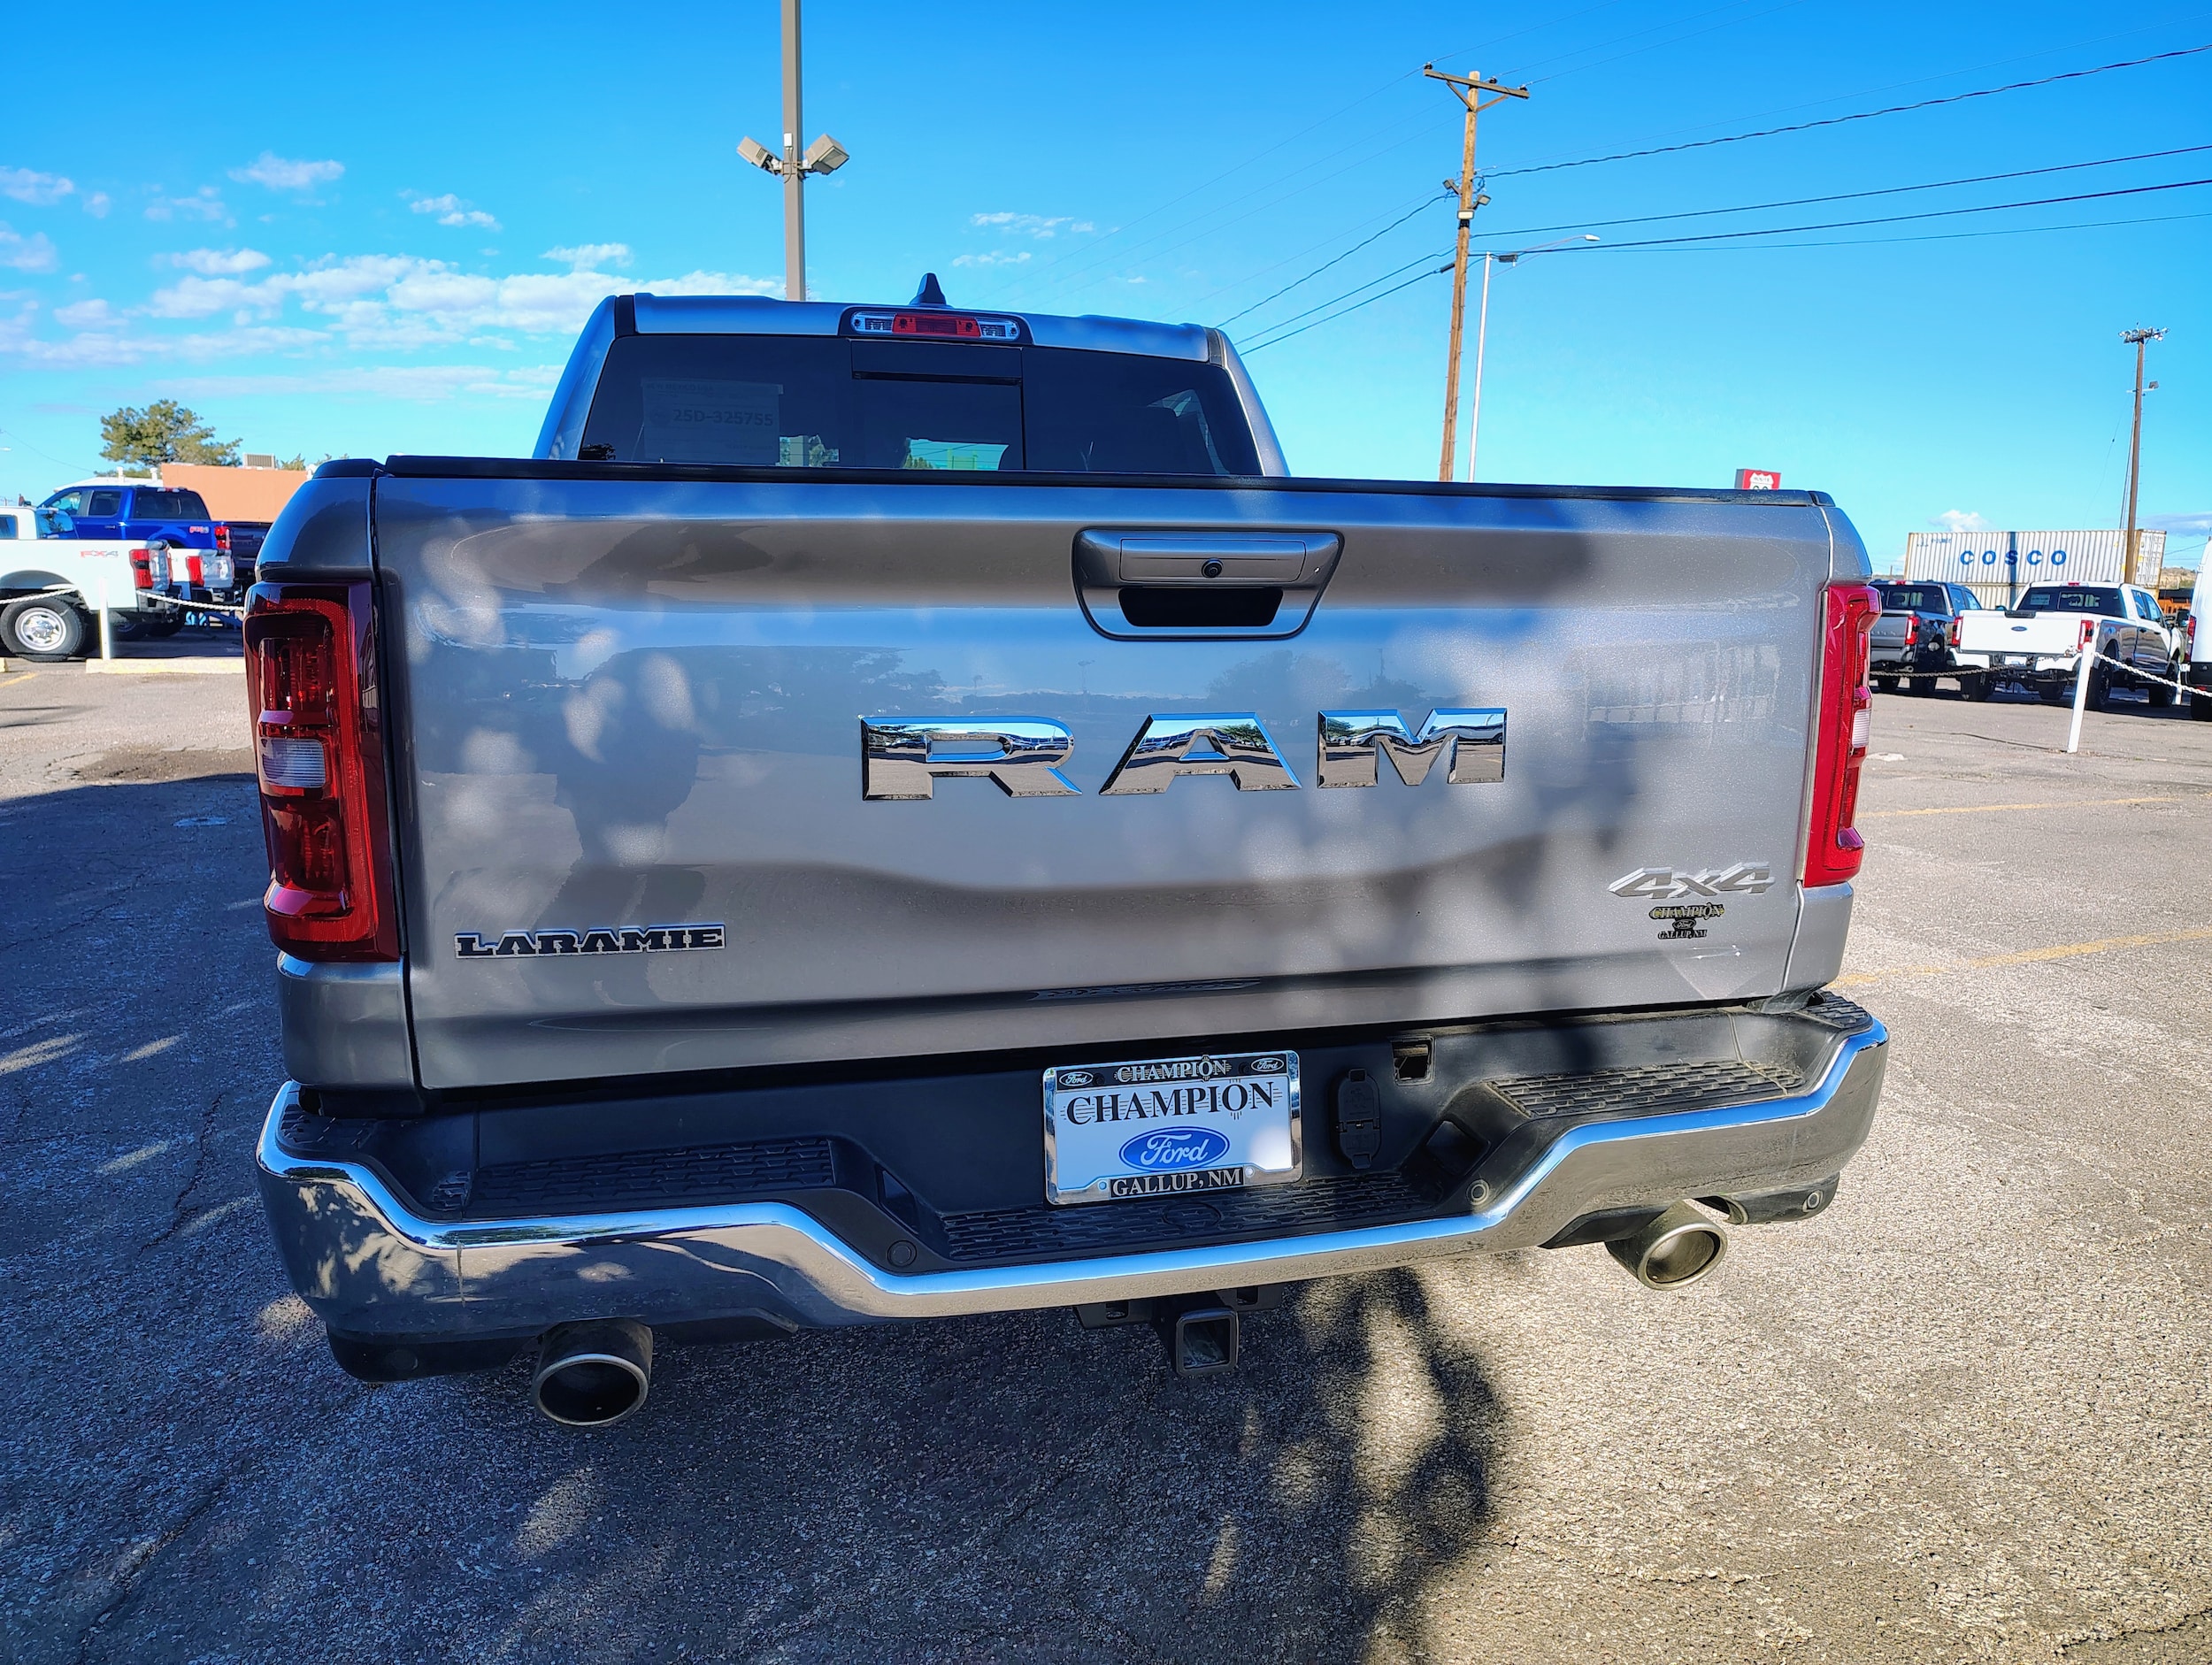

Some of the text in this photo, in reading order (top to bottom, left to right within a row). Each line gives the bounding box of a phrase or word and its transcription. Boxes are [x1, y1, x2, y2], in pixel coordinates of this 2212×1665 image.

[672, 409, 774, 426] 25D-325755
[80, 549, 119, 558] FX4
[1960, 549, 2067, 565] COSCO
[860, 708, 1508, 801] RAM
[1651, 903, 1722, 918] CHAMPION
[454, 924, 726, 959] LARAMIE
[1064, 1059, 1279, 1085] Ford CHAMPION Ford
[1066, 1080, 1275, 1125] CHAMPION
[1139, 1132, 1210, 1166] Ford
[1112, 1168, 1242, 1196] GALLUP, NM
